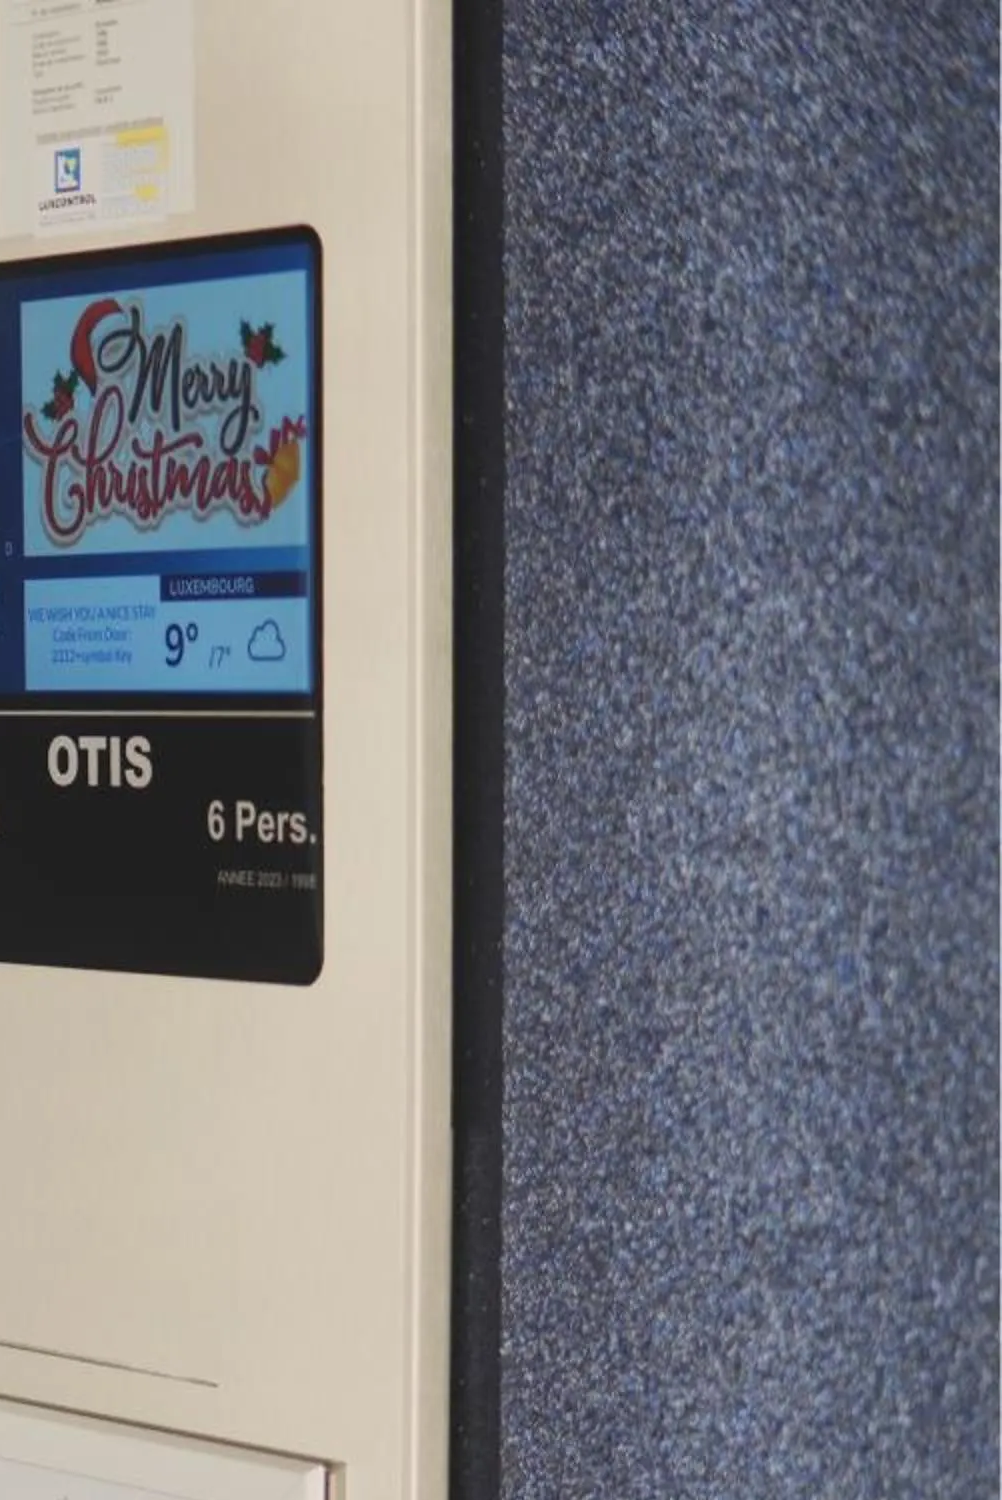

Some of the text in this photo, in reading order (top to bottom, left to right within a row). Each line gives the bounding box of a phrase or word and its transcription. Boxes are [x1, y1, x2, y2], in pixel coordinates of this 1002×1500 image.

[98, 304, 259, 455] Merry
[24, 385, 273, 536] Christmas
[169, 577, 255, 596] LUXEMBOURG
[47, 735, 153, 787] OTIS
[207, 799, 317, 844] 6 Pers.
